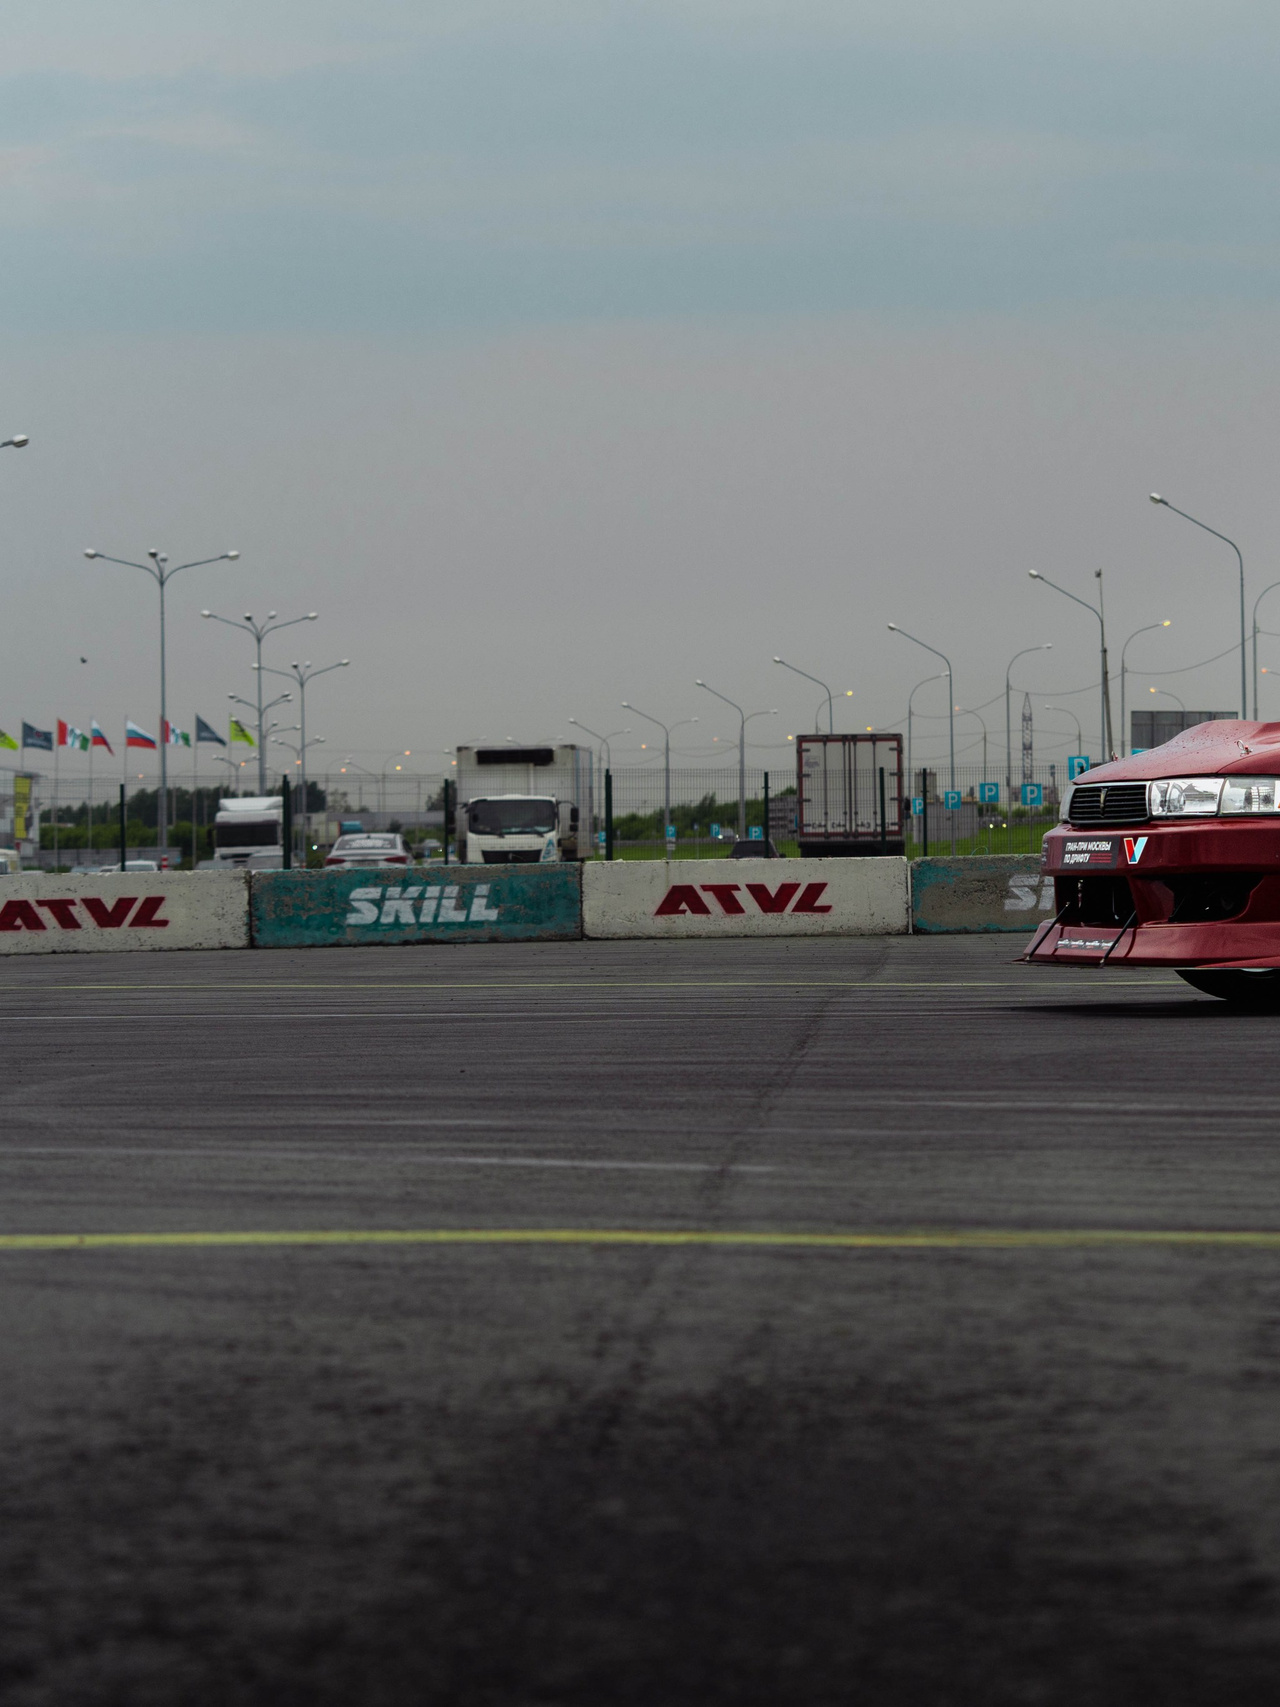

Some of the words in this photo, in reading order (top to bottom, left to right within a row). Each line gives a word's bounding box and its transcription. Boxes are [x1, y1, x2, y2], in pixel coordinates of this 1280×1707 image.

[1065, 842, 1088, 852] ГРАН-ПРИ
[1088, 841, 1112, 851] МОСКВЫ
[1069, 853, 1091, 865] ДРИФТУ
[0, 896, 170, 931] ATVL
[346, 884, 500, 926] SKILL
[654, 882, 833, 916] ATVL
